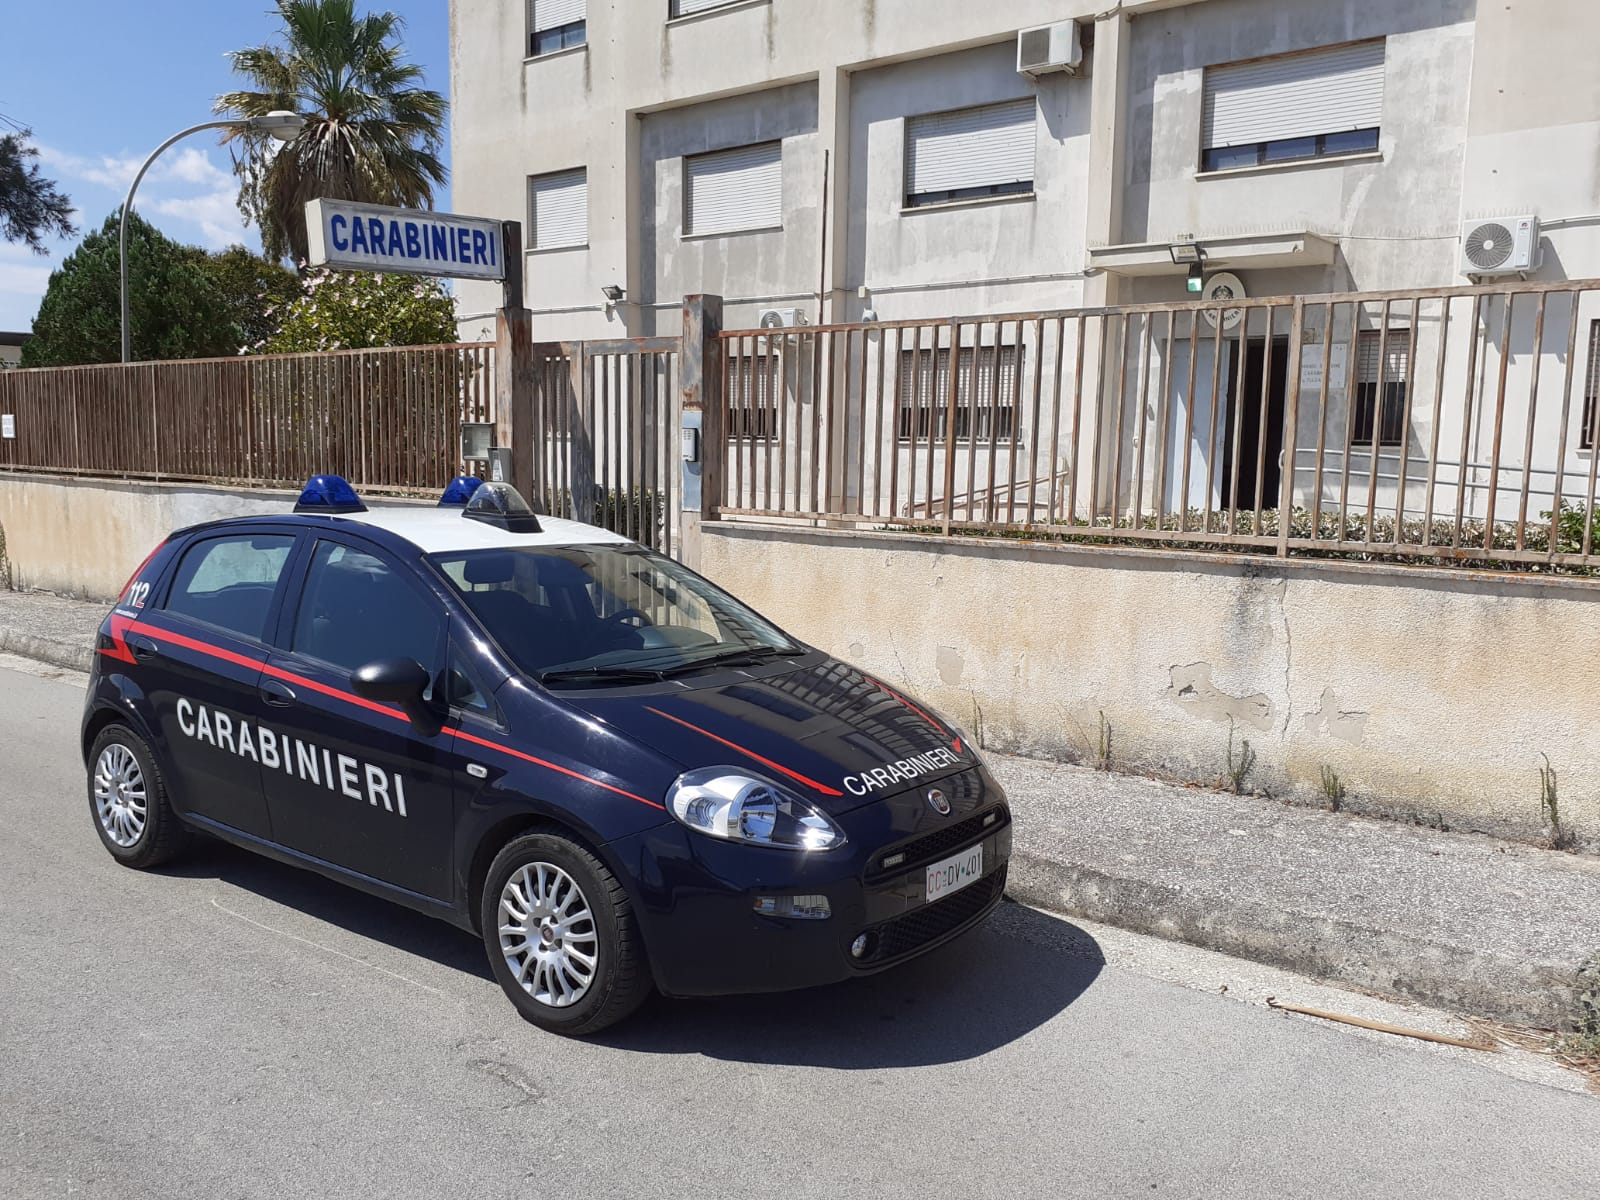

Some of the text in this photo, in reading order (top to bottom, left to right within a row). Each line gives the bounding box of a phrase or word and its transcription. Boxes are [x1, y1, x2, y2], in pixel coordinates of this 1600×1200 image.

[331, 214, 496, 266] CARABINIERI
[127, 581, 150, 608] 112
[176, 698, 407, 817] CARABINIERI
[843, 747, 960, 796] CARABINIERI
